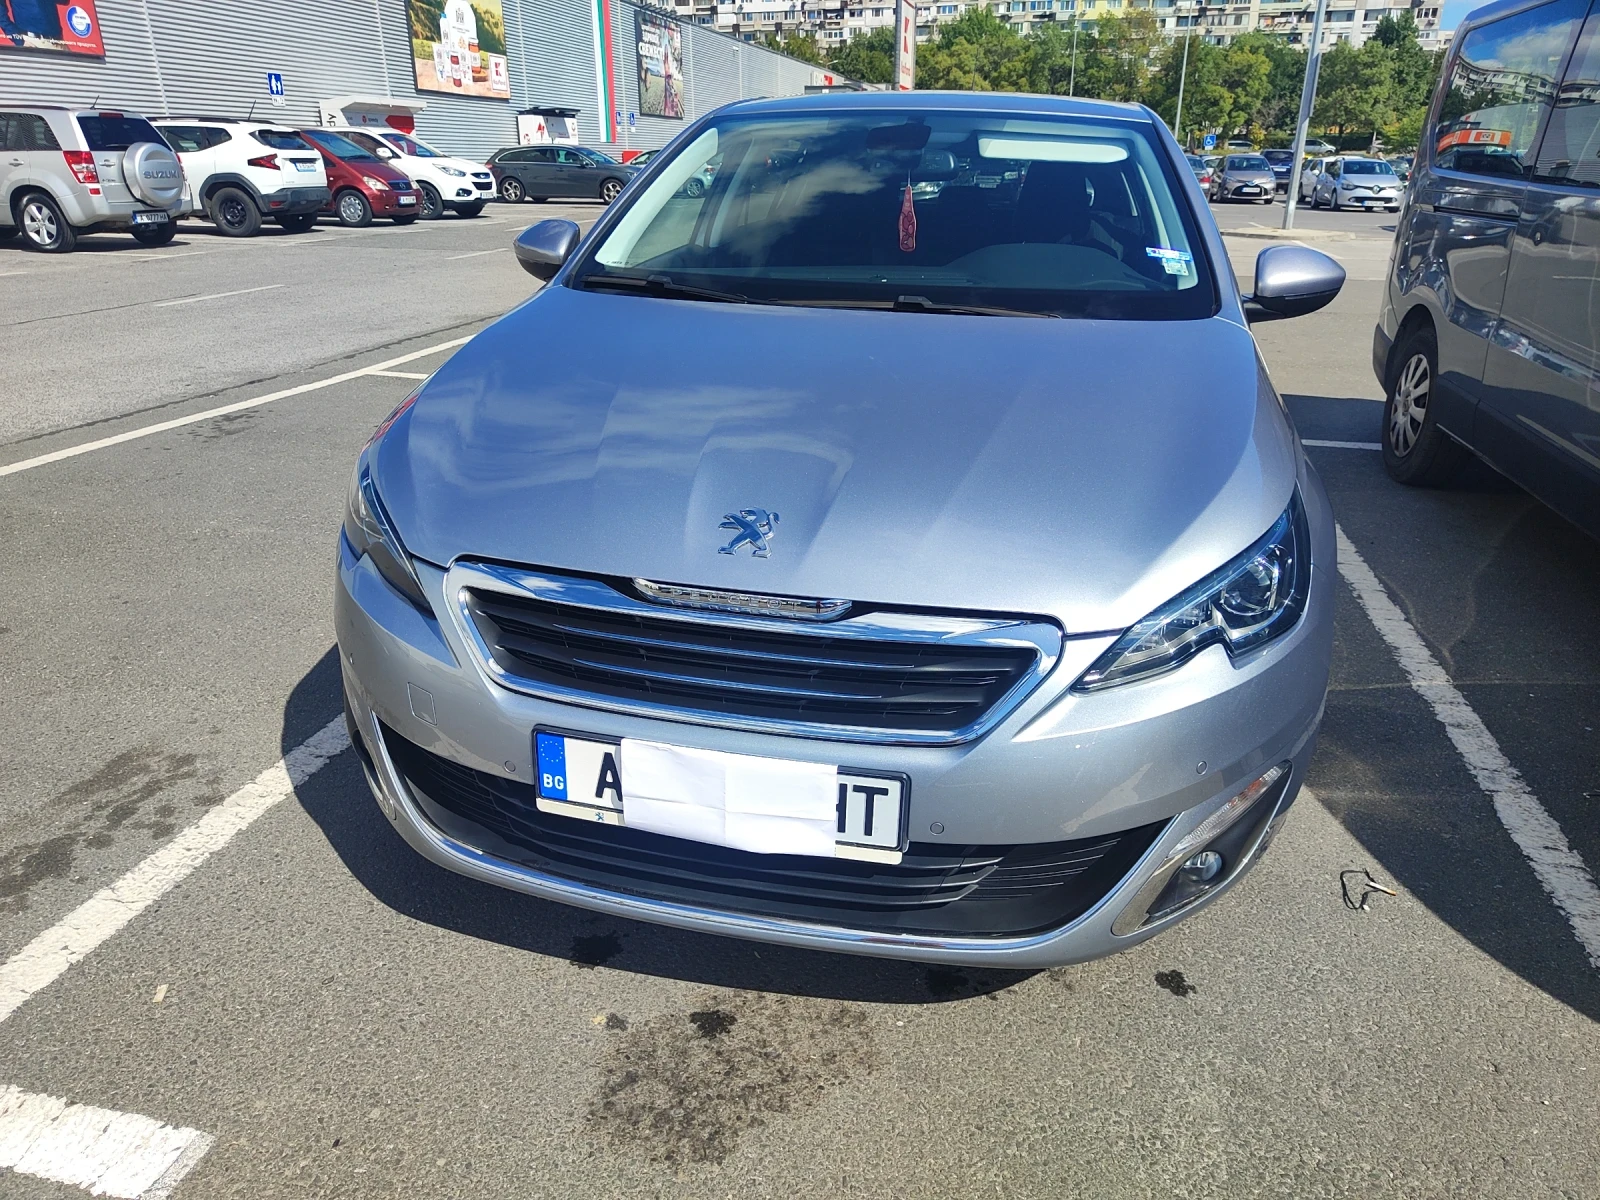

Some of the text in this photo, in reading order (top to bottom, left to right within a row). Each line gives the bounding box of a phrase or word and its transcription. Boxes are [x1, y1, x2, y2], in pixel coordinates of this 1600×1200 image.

[143, 170, 180, 179] SUZUKI
[670, 587, 802, 611] PEUGEOT
[543, 773, 565, 791] BG
[594, 751, 624, 803] A
